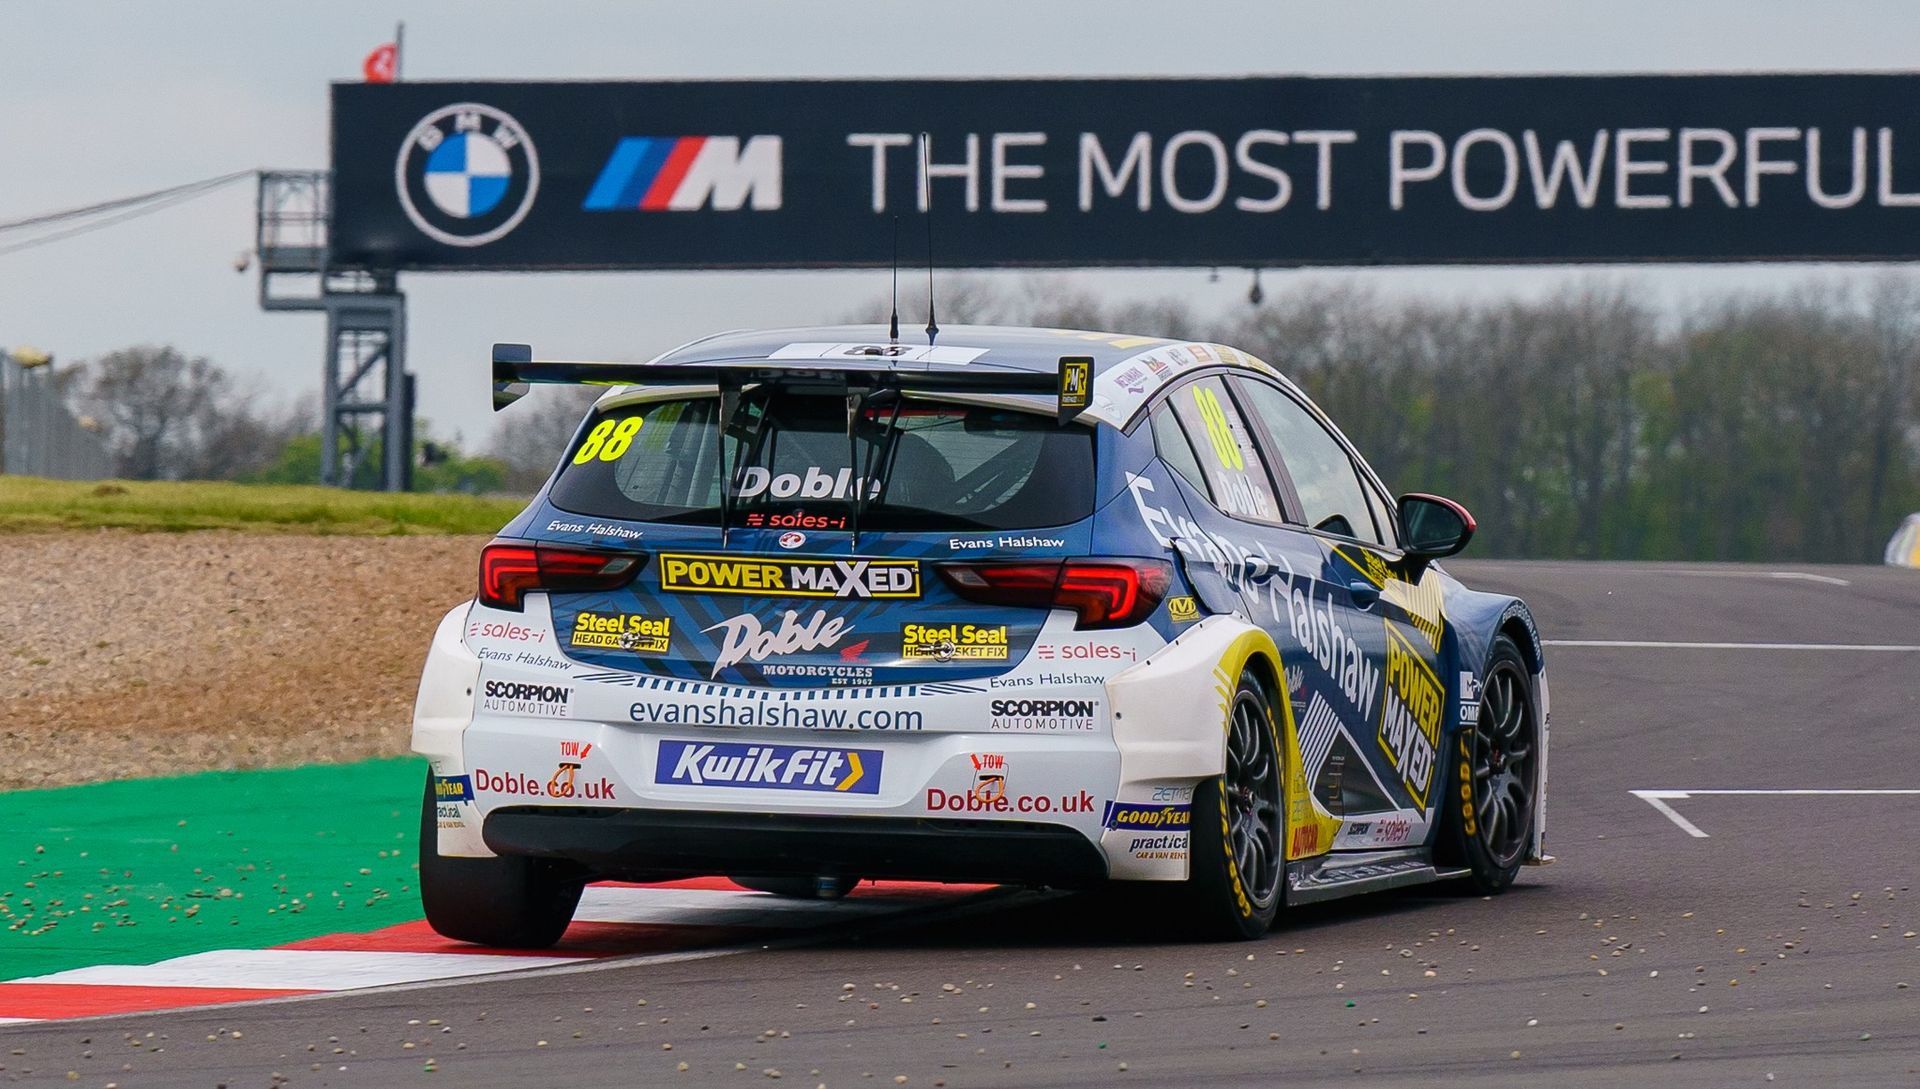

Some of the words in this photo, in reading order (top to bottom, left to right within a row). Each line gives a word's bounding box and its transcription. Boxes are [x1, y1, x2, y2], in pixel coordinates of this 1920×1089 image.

[416, 111, 520, 151] BMW
[846, 131, 1047, 213] THE
[1078, 129, 1357, 213] MOST
[1388, 125, 1920, 211] POWERFUL
[1064, 367, 1087, 392] PMR
[573, 416, 644, 465] 88
[733, 466, 881, 500] Doble
[546, 519, 583, 534] Evans
[586, 521, 644, 540] Halshaw
[769, 511, 846, 529] sales-i
[949, 537, 994, 551] Evans
[998, 535, 1065, 550] Halshaw
[667, 559, 785, 589] POWER
[481, 621, 546, 643] sales-i
[575, 612, 625, 633] Steel
[629, 615, 671, 636] Seal
[904, 624, 959, 644] Steel
[961, 624, 1008, 644] Seal
[574, 633, 603, 644] HEAD
[700, 609, 856, 681] Doble
[477, 647, 513, 664] Evans
[515, 651, 572, 671] Halshaw
[987, 647, 1005, 657] FIX
[1062, 641, 1137, 662] sales-i
[763, 664, 873, 678] MOTORCYCLES
[832, 677, 848, 685] EST
[990, 676, 1033, 688] Evans
[1039, 672, 1105, 686] Halshaw
[484, 680, 568, 704] SCORPION
[1388, 638, 1440, 746] POWER
[483, 699, 567, 717] AUTOMOTIVE
[629, 699, 923, 732] evanshalshaw.com
[990, 699, 1094, 718] SCORPION
[990, 717, 1093, 730] AUTOMOTIVE
[560, 741, 580, 756] TOW
[1383, 686, 1434, 792] MAXED
[982, 754, 1003, 769] TOW
[475, 768, 616, 800] Doble.co.uk
[926, 788, 1095, 813] Doble.co.uk
